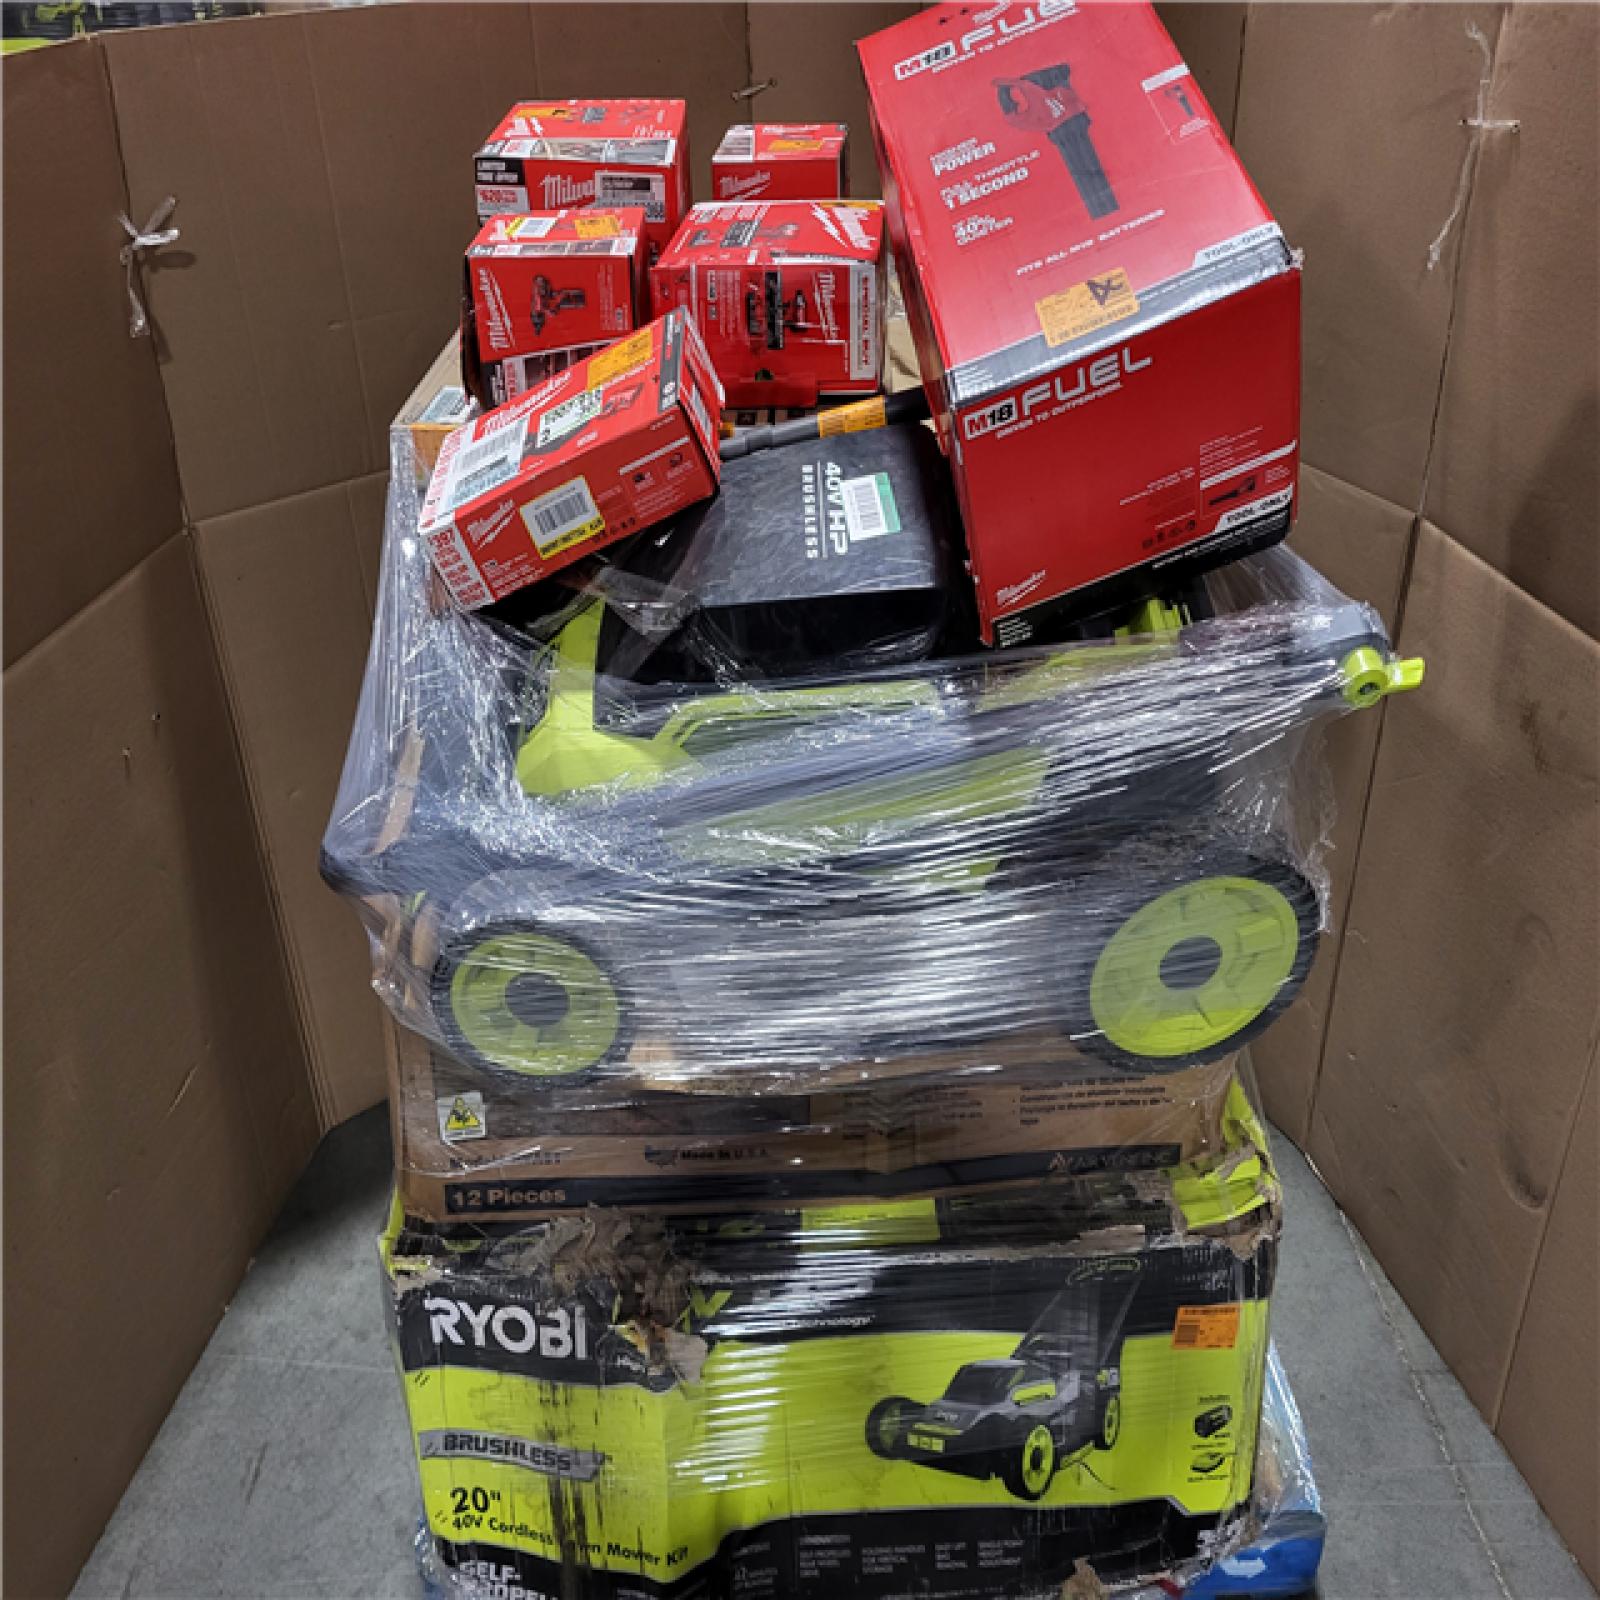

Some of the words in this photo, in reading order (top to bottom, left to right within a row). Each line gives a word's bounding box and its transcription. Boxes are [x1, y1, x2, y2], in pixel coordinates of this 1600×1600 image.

[963, 396, 1017, 440] M18
[1022, 346, 1153, 416] FUEL
[829, 508, 849, 556] HP
[452, 1189, 482, 1207] 12
[487, 1187, 567, 1207] Pieces
[424, 1298, 589, 1361] RYOBI
[443, 1433, 572, 1472] BRUSHLESS
[449, 1487, 501, 1514] 20"
[606, 1543, 661, 1566] Mower
